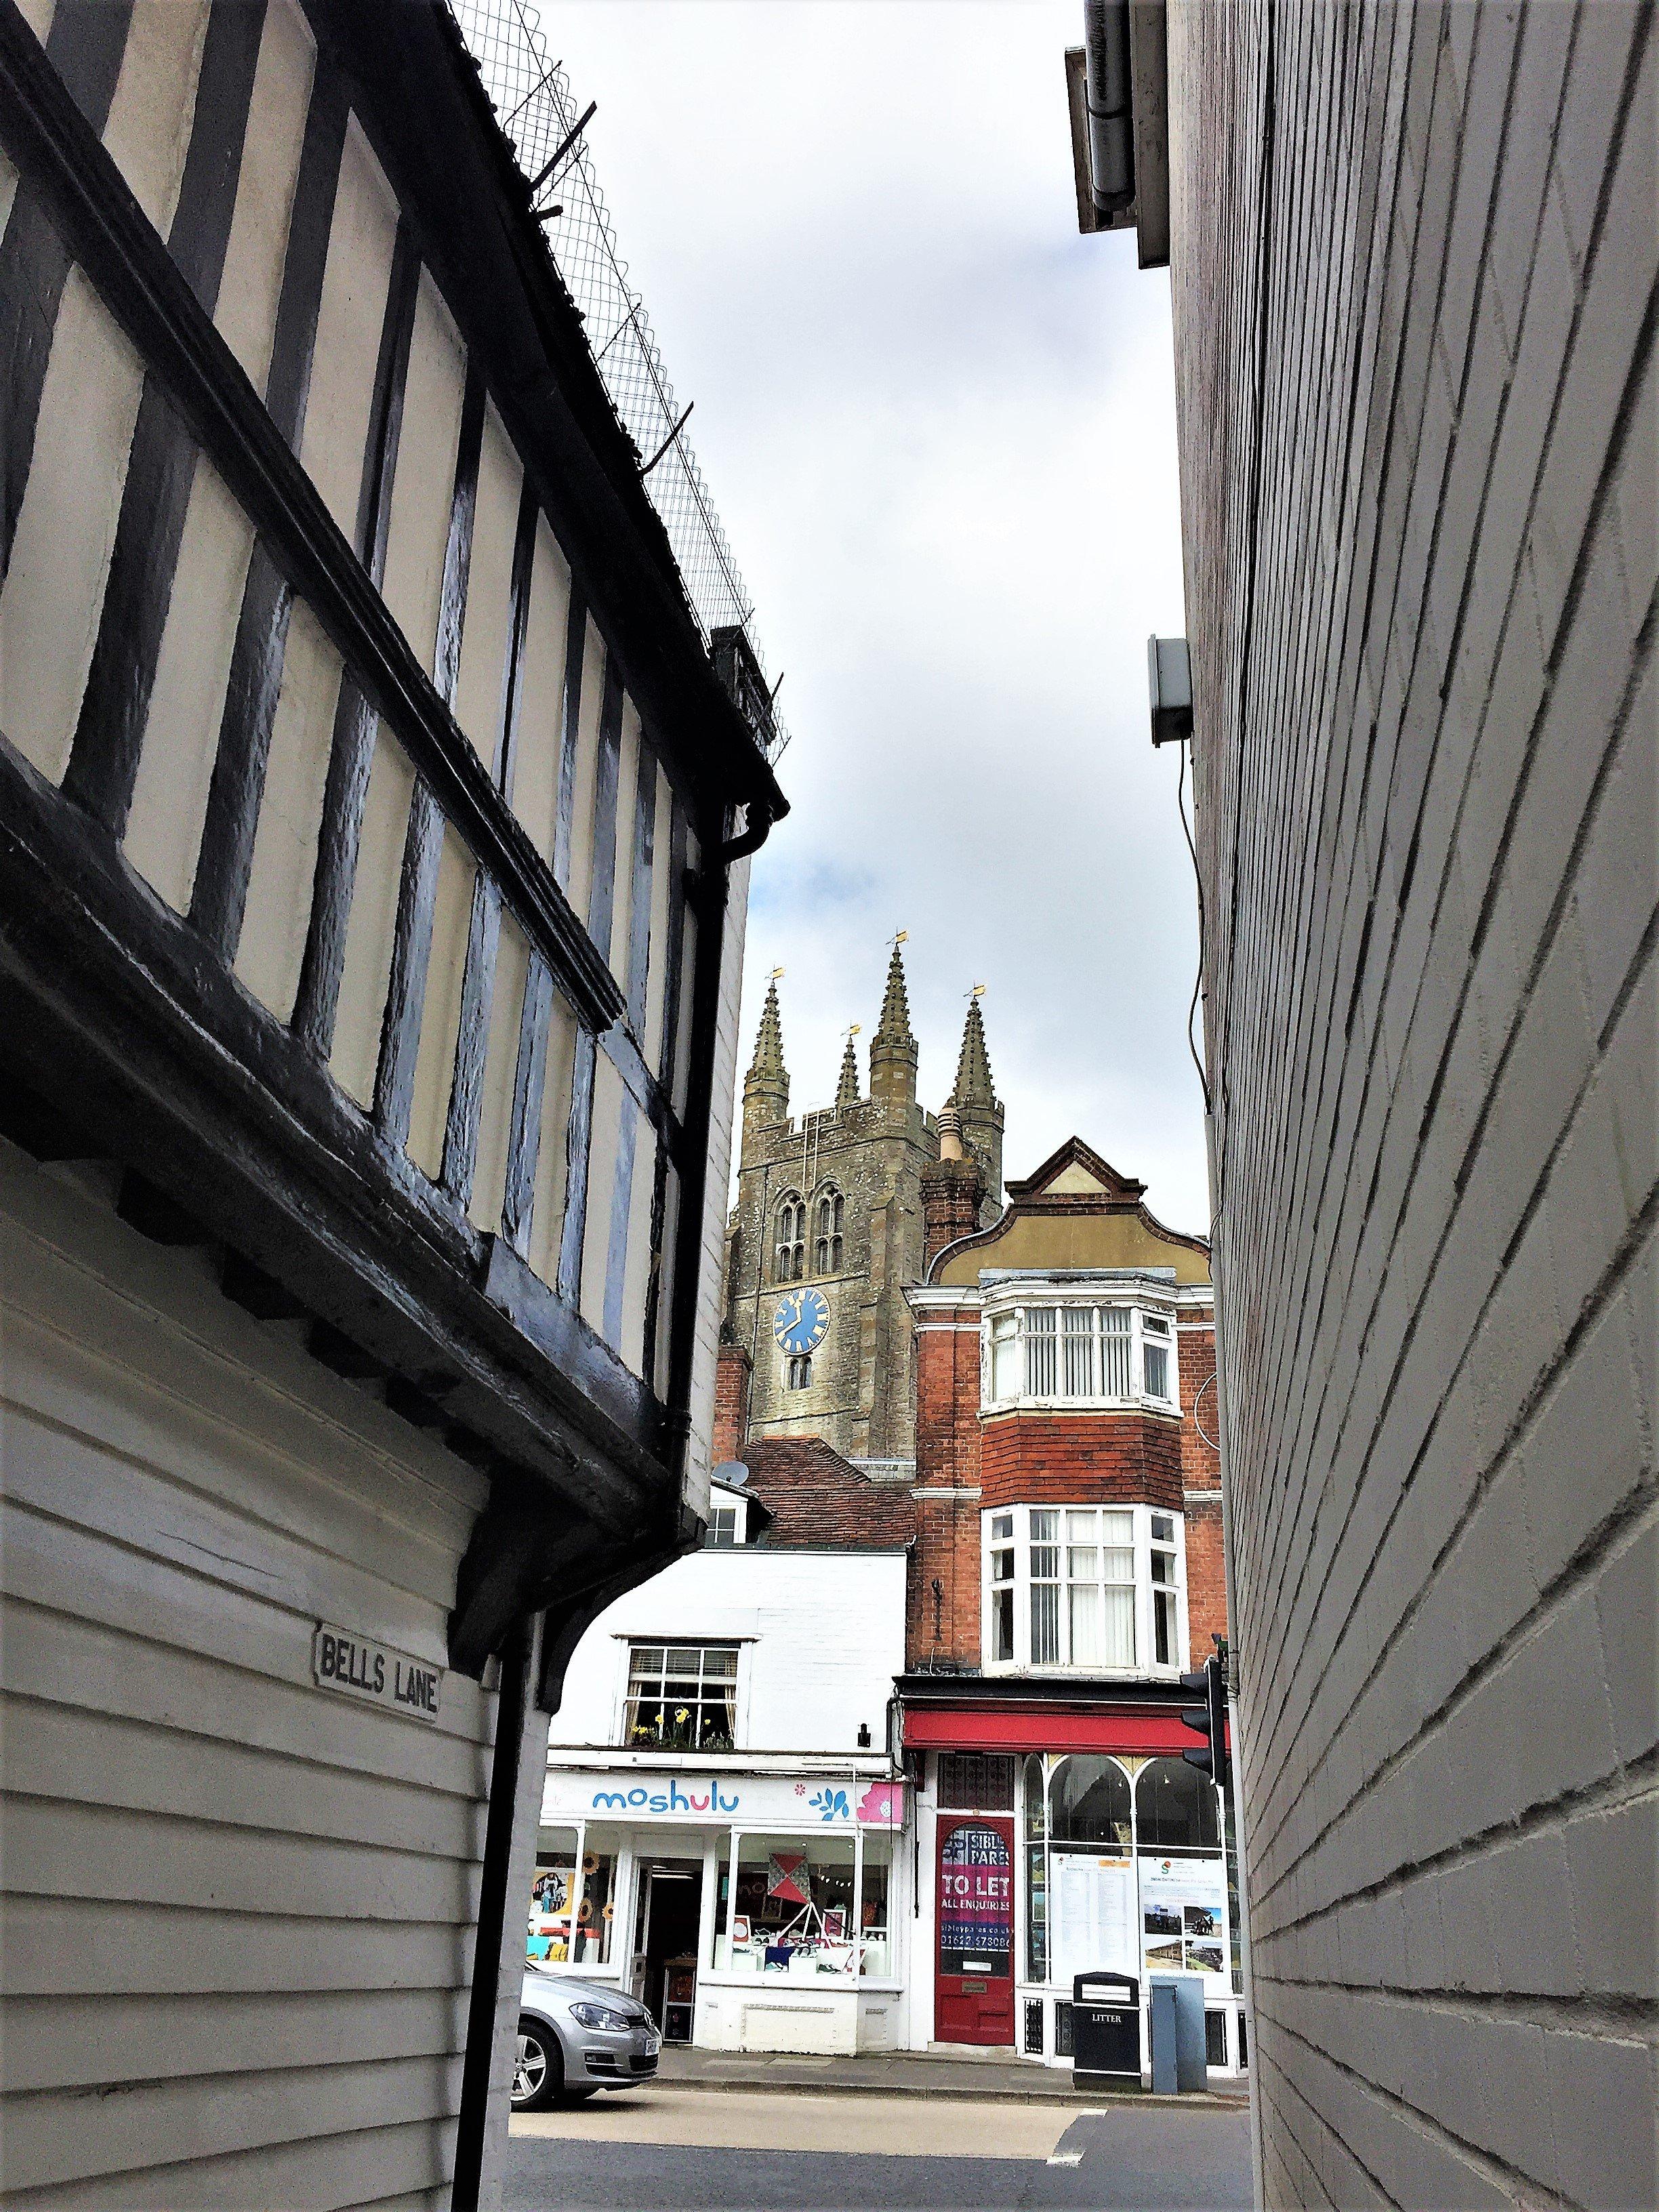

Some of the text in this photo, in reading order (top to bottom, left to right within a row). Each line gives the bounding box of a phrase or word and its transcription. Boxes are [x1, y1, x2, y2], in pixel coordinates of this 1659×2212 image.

[320, 1633, 438, 1713] BELLS LANE
[592, 1779, 739, 1813] moshulu
[941, 1875, 1010, 1897] TO LET
[941, 1898, 1010, 1911] ALL ENQUIRIES
[1092, 2013, 1122, 2023] LITTER
